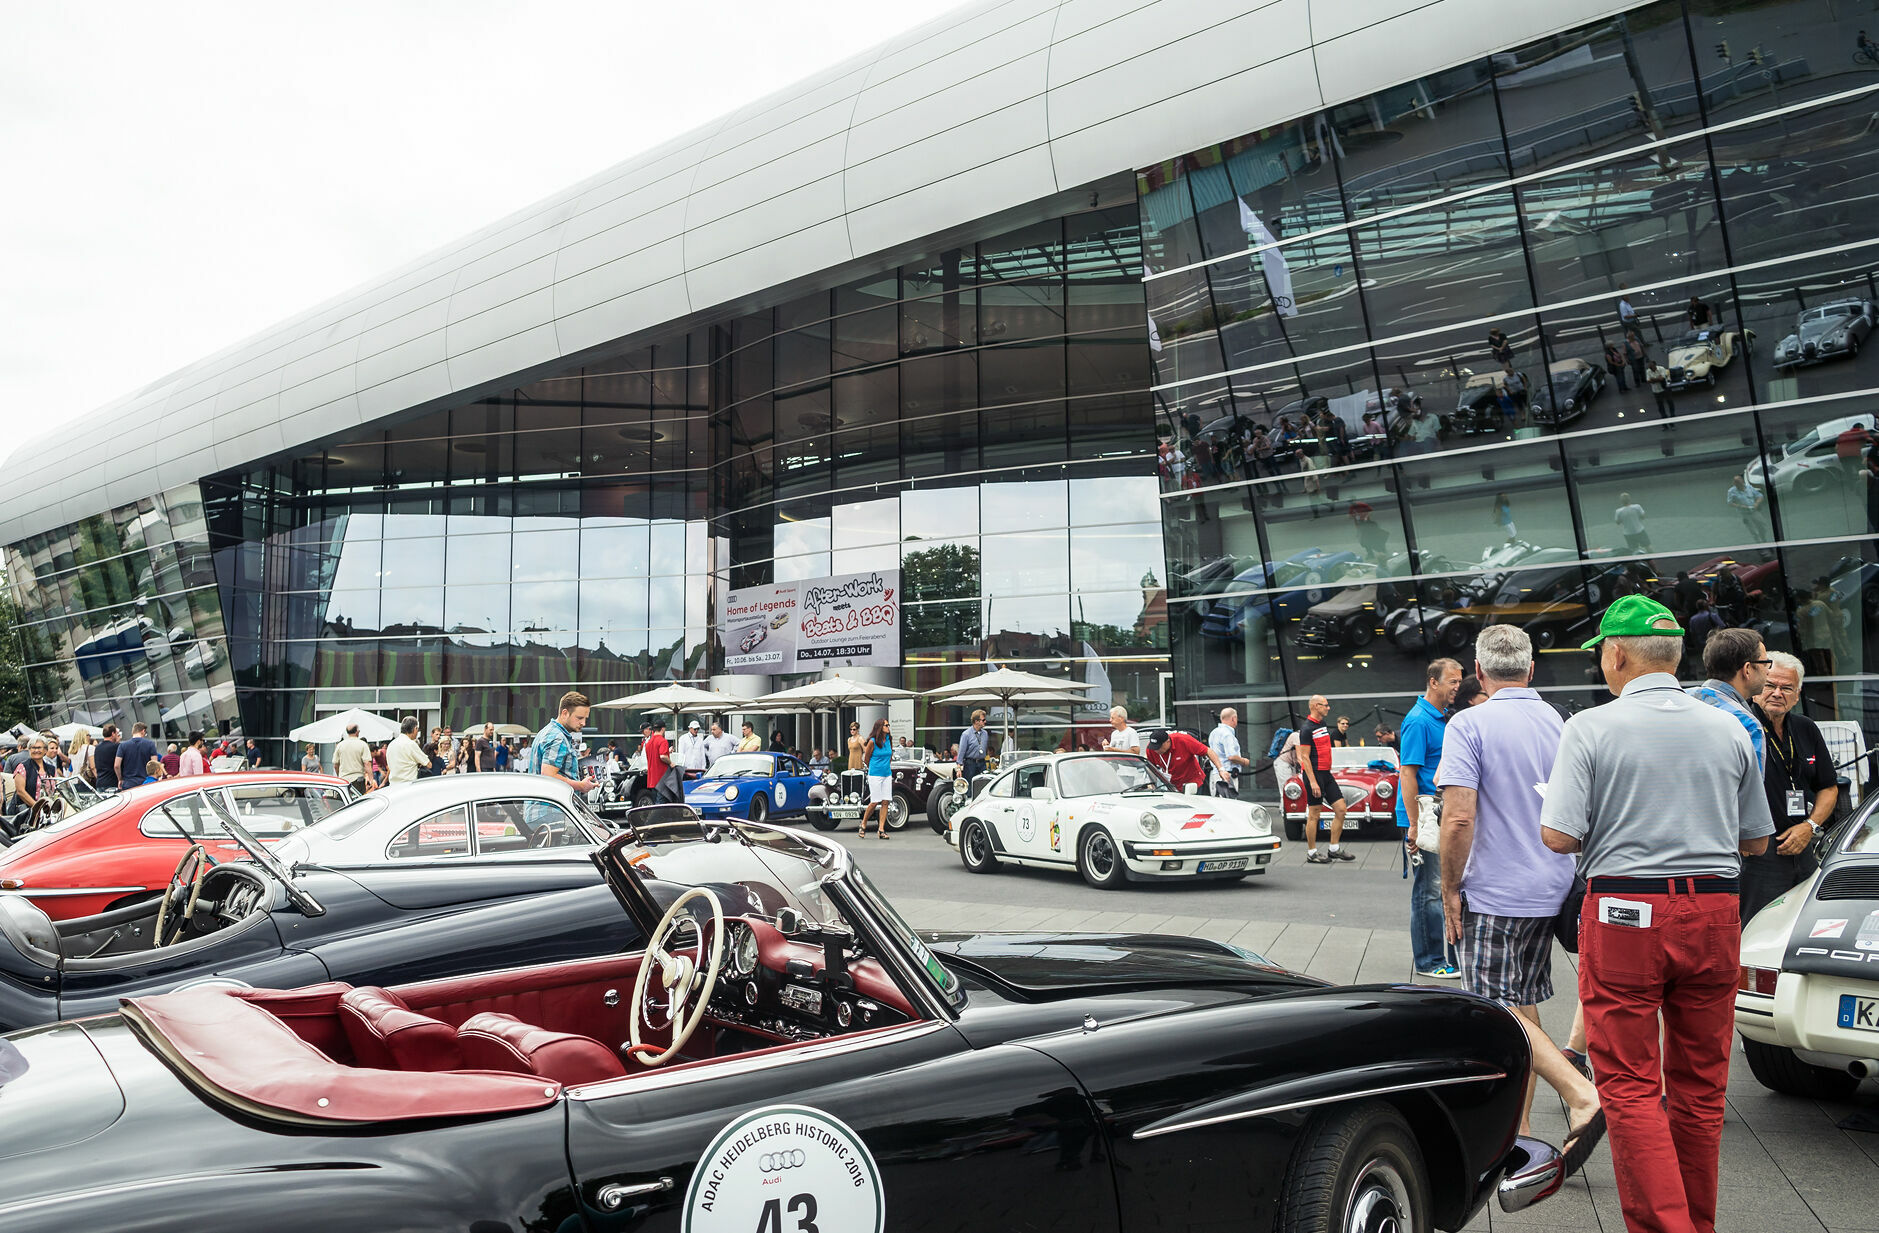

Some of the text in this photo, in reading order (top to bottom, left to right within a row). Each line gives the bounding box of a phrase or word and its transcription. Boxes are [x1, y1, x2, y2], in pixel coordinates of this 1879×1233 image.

[804, 573, 883, 615] After-Work
[727, 598, 796, 616] Home of Legends
[833, 602, 851, 611] meets
[805, 605, 894, 638] Beats & BBQ
[811, 637, 828, 645] Outdoor
[829, 635, 847, 644] Lounge
[836, 647, 856, 655] 18:30
[857, 646, 870, 654] Uhr
[1022, 818, 1030, 830] 73
[1203, 861, 1246, 871] HD OP 911H
[1843, 1014, 1850, 1022] D
[1857, 1001, 1879, 1027] K
[702, 1122, 865, 1212] ADAC HEIDELBERG HISTORIC 2016
[762, 1176, 782, 1186] Audi
[755, 1193, 819, 1233] 43
